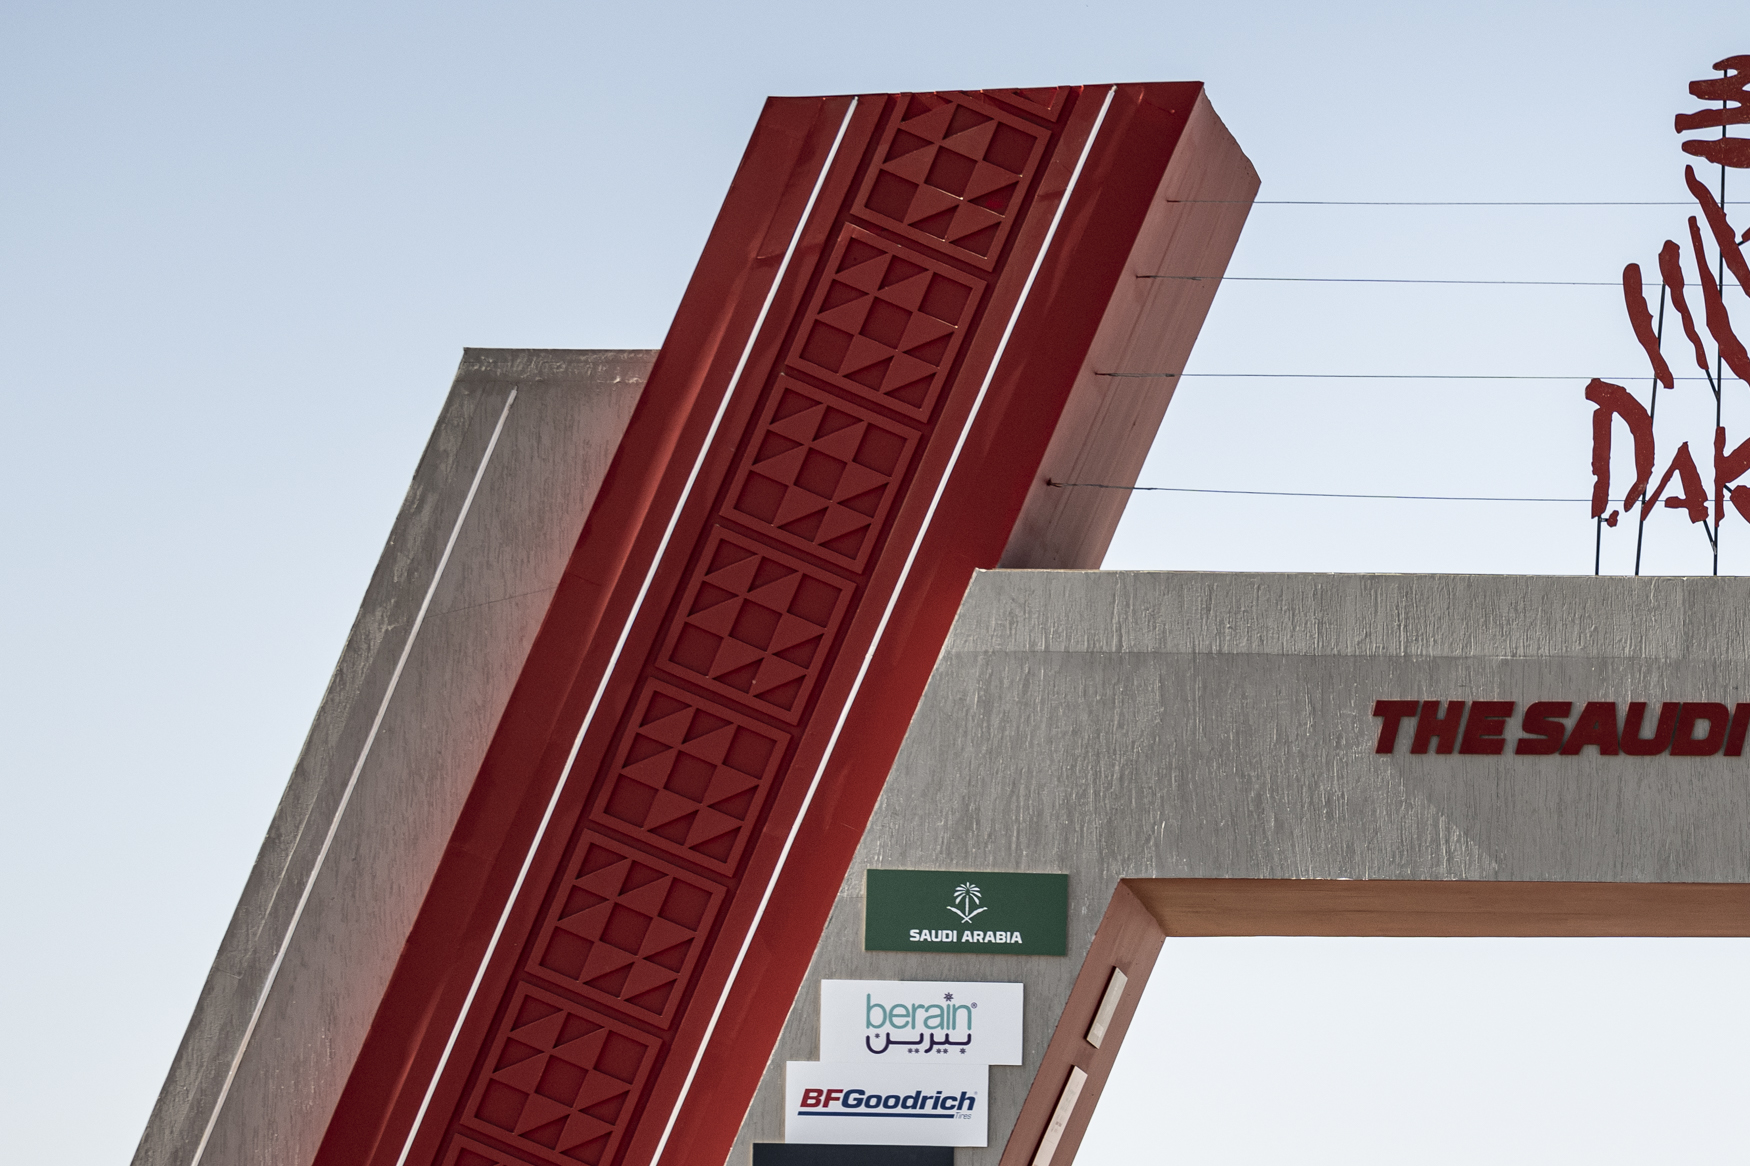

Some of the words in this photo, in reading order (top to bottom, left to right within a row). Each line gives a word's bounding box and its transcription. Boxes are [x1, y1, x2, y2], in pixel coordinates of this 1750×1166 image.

[1372, 700, 1515, 756] THE
[909, 928, 958, 944] SAUDI
[962, 930, 1022, 944] ARABIA
[866, 992, 973, 1032] berain
[866, 1032, 972, 1055] بيرين
[800, 1088, 976, 1112] BFGoodrich
[954, 1112, 972, 1120] Tires
